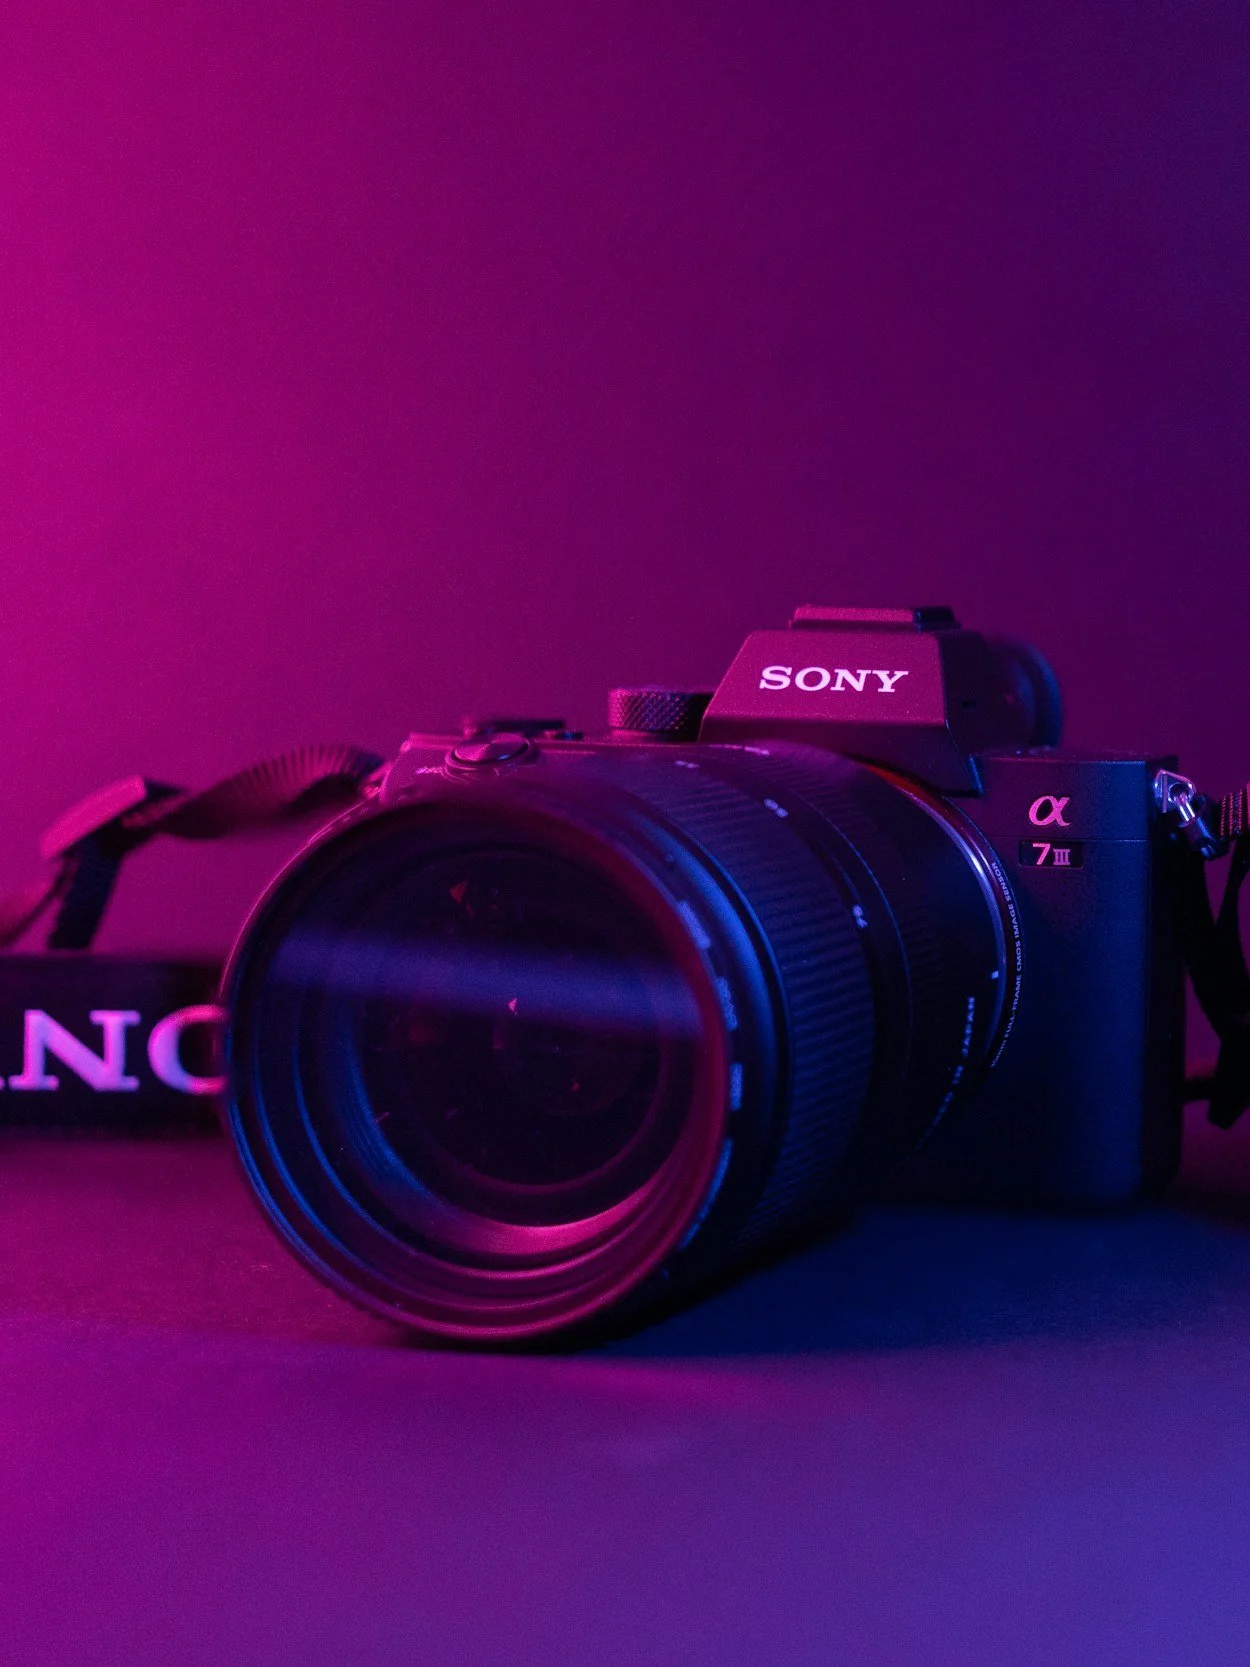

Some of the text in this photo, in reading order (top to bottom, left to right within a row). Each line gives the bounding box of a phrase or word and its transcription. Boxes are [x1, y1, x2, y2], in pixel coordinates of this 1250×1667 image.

[759, 665, 909, 693] SONY
[992, 862, 1012, 902] SENSOR
[1007, 903, 1021, 939] IMAGE
